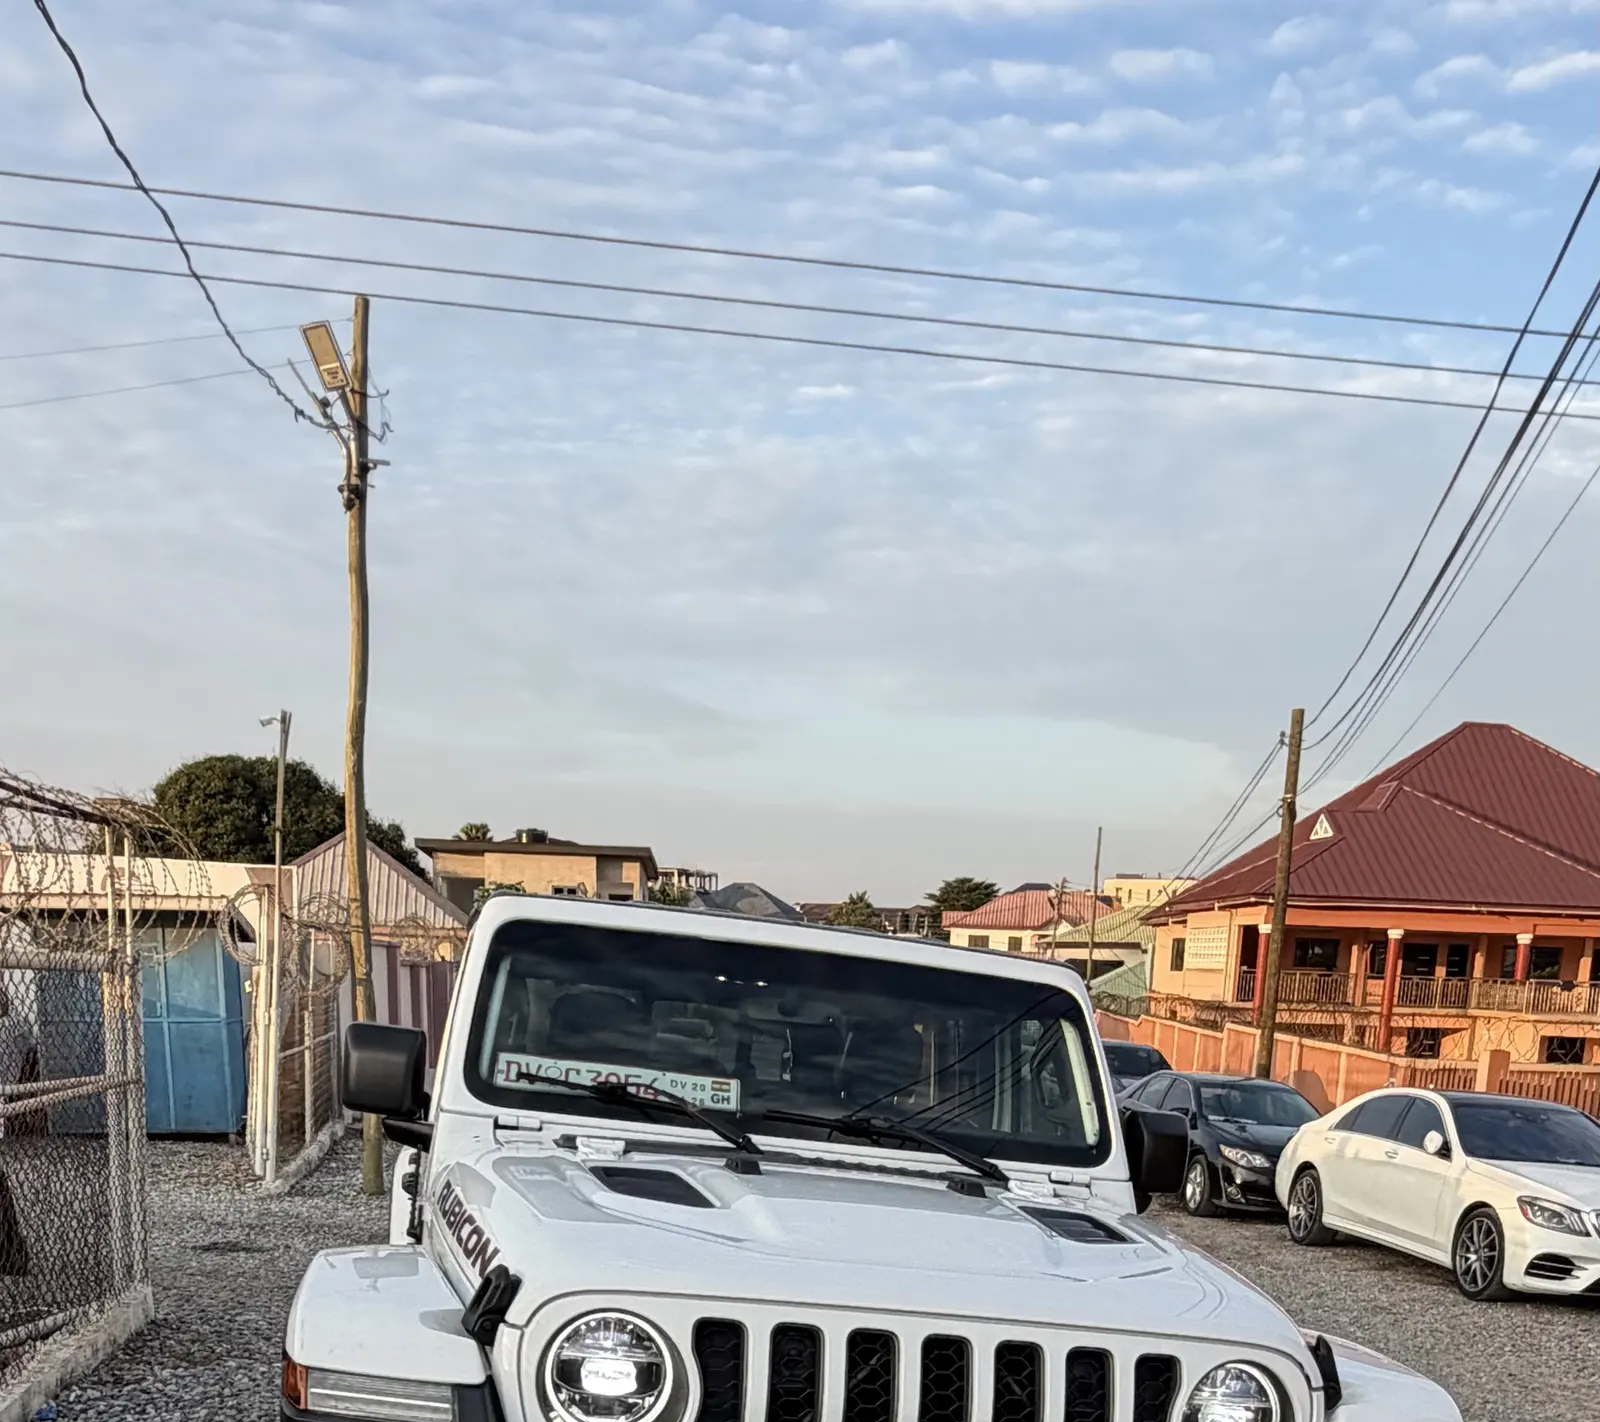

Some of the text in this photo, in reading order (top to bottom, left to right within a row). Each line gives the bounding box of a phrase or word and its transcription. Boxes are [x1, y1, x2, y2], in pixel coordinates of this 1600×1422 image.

[670, 1079, 687, 1090] DV
[710, 1093, 731, 1105] GH
[437, 1179, 501, 1280] RUBICON
